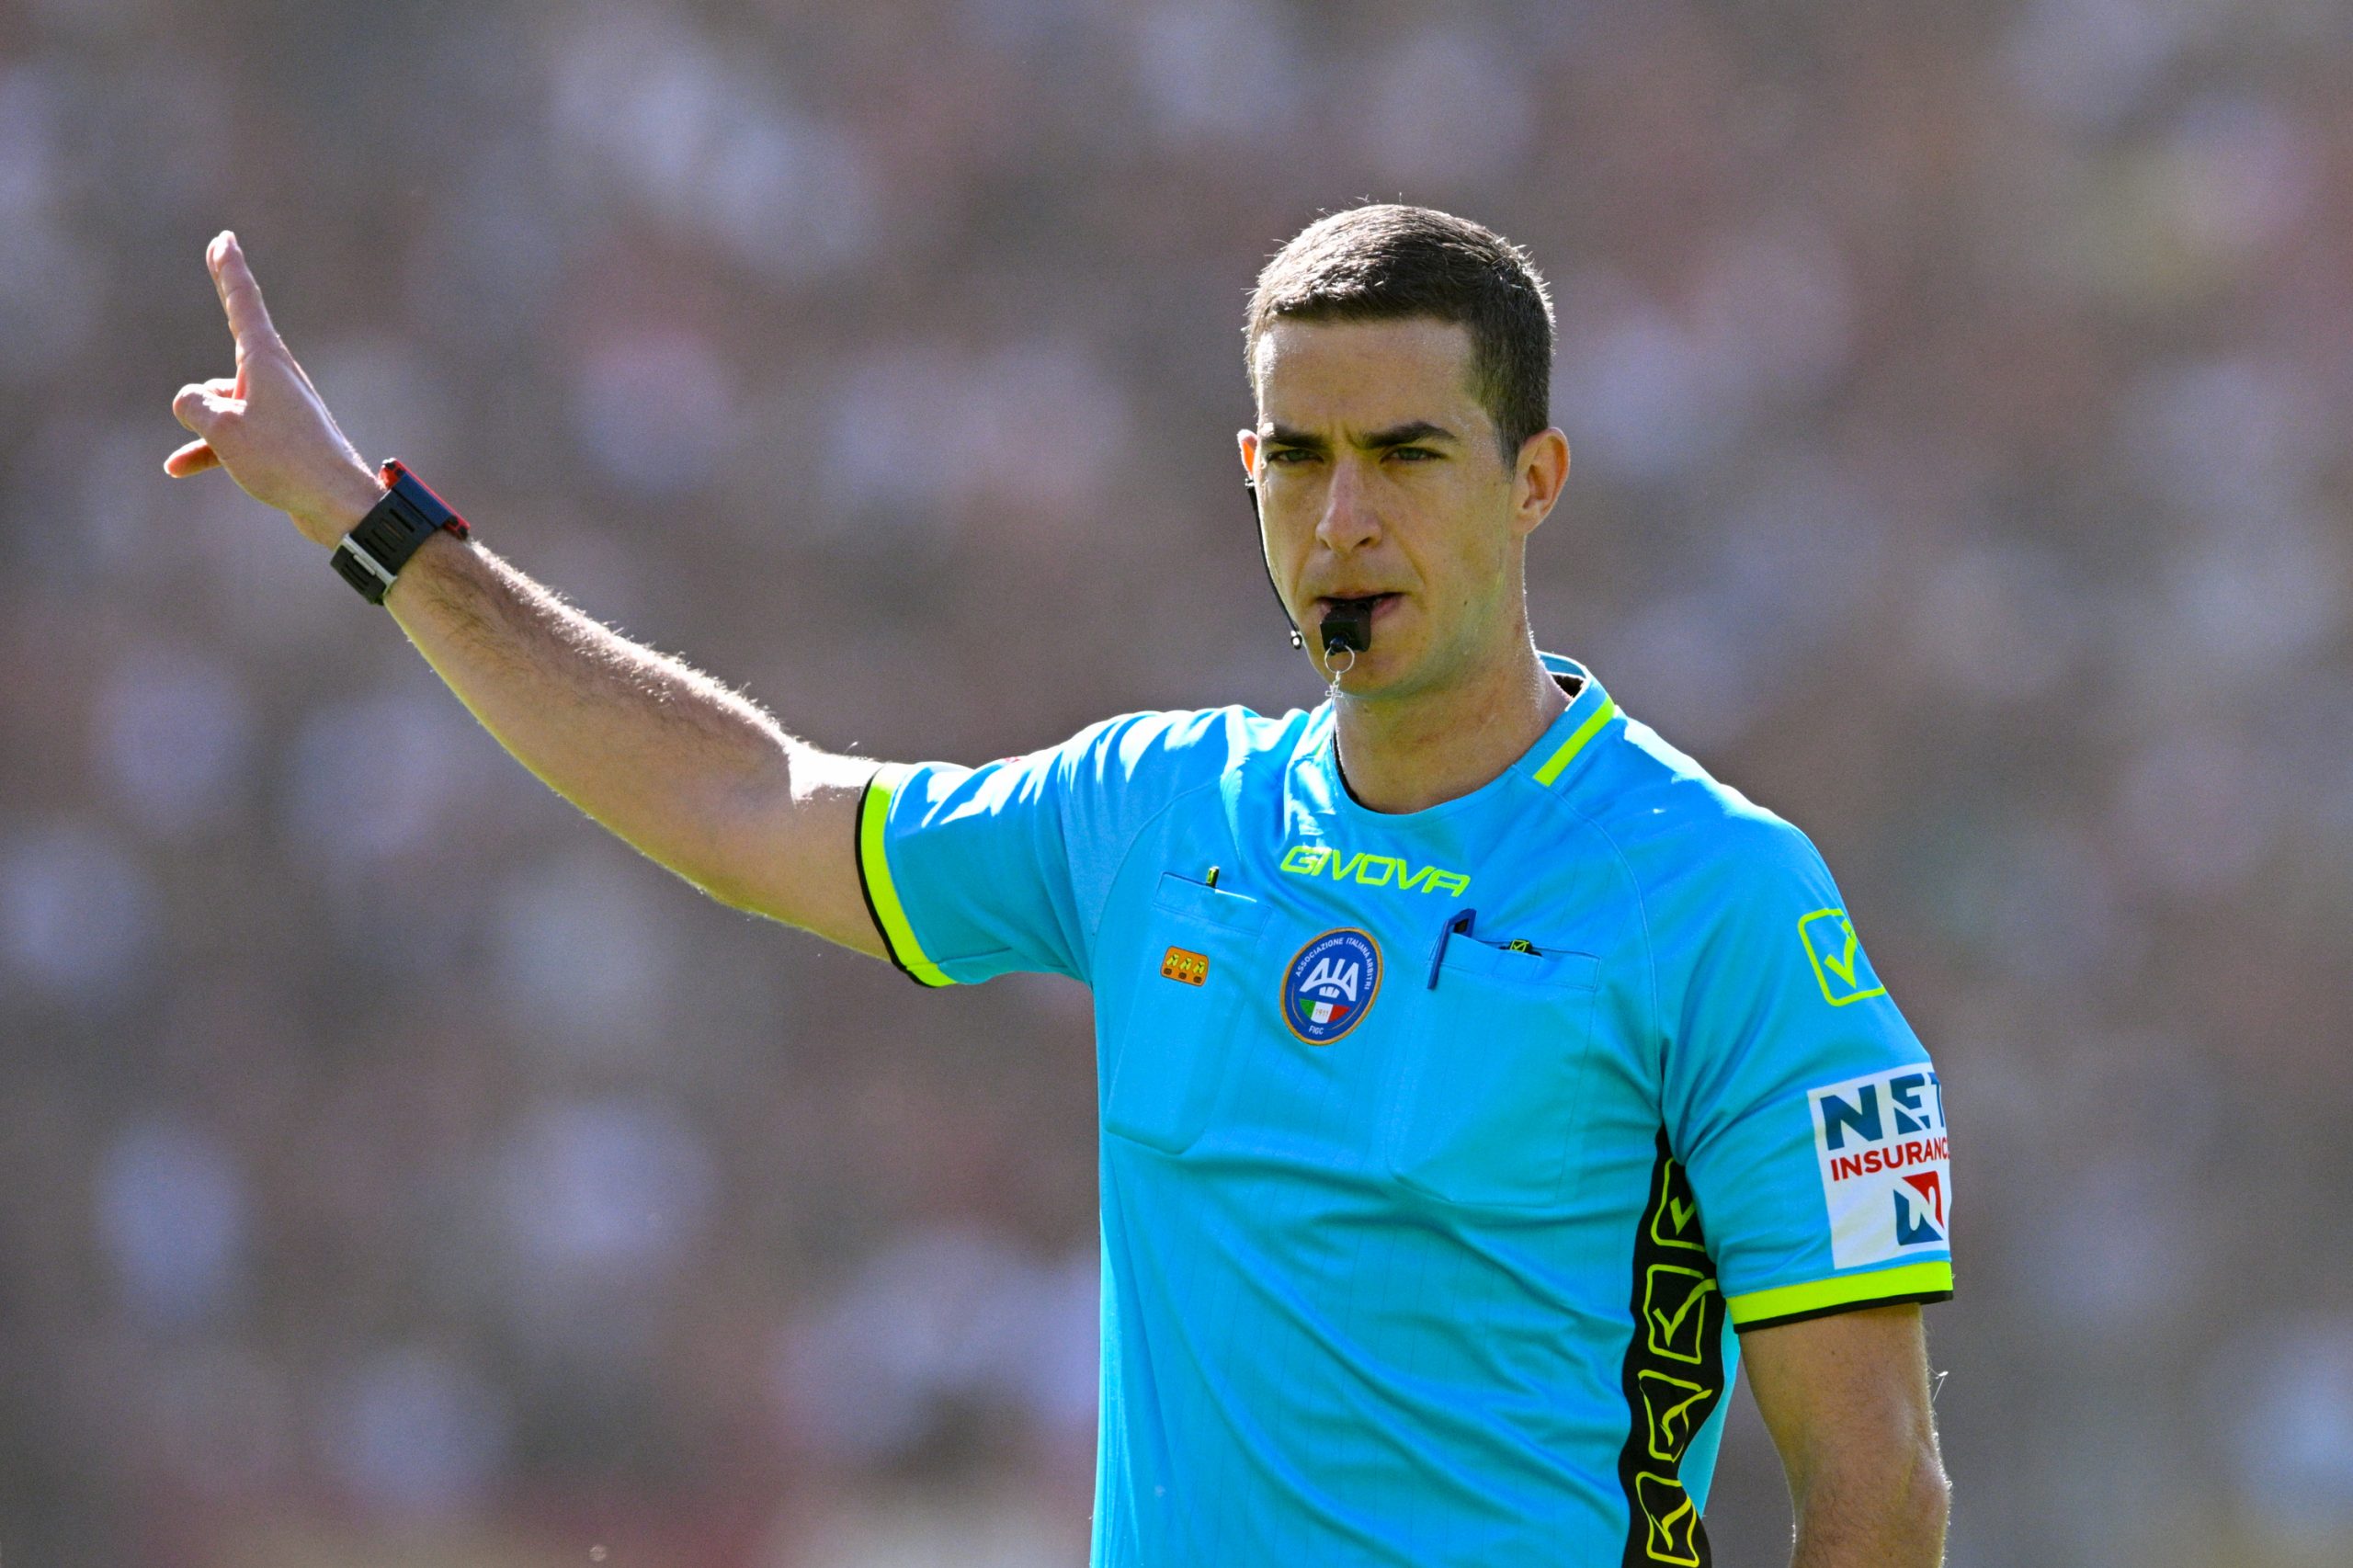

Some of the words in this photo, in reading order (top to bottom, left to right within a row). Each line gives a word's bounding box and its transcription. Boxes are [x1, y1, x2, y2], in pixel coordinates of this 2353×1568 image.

[1279, 846, 1471, 898] GIVOVA
[1295, 937, 1344, 978] ASSOCIAZIONE
[1346, 937, 1370, 959] ITALIANA
[1363, 958, 1374, 991] ARBITRI
[1299, 957, 1359, 1002] AIA
[1308, 1025, 1324, 1036] FIGC
[1830, 1137, 1950, 1182] INSURANC
